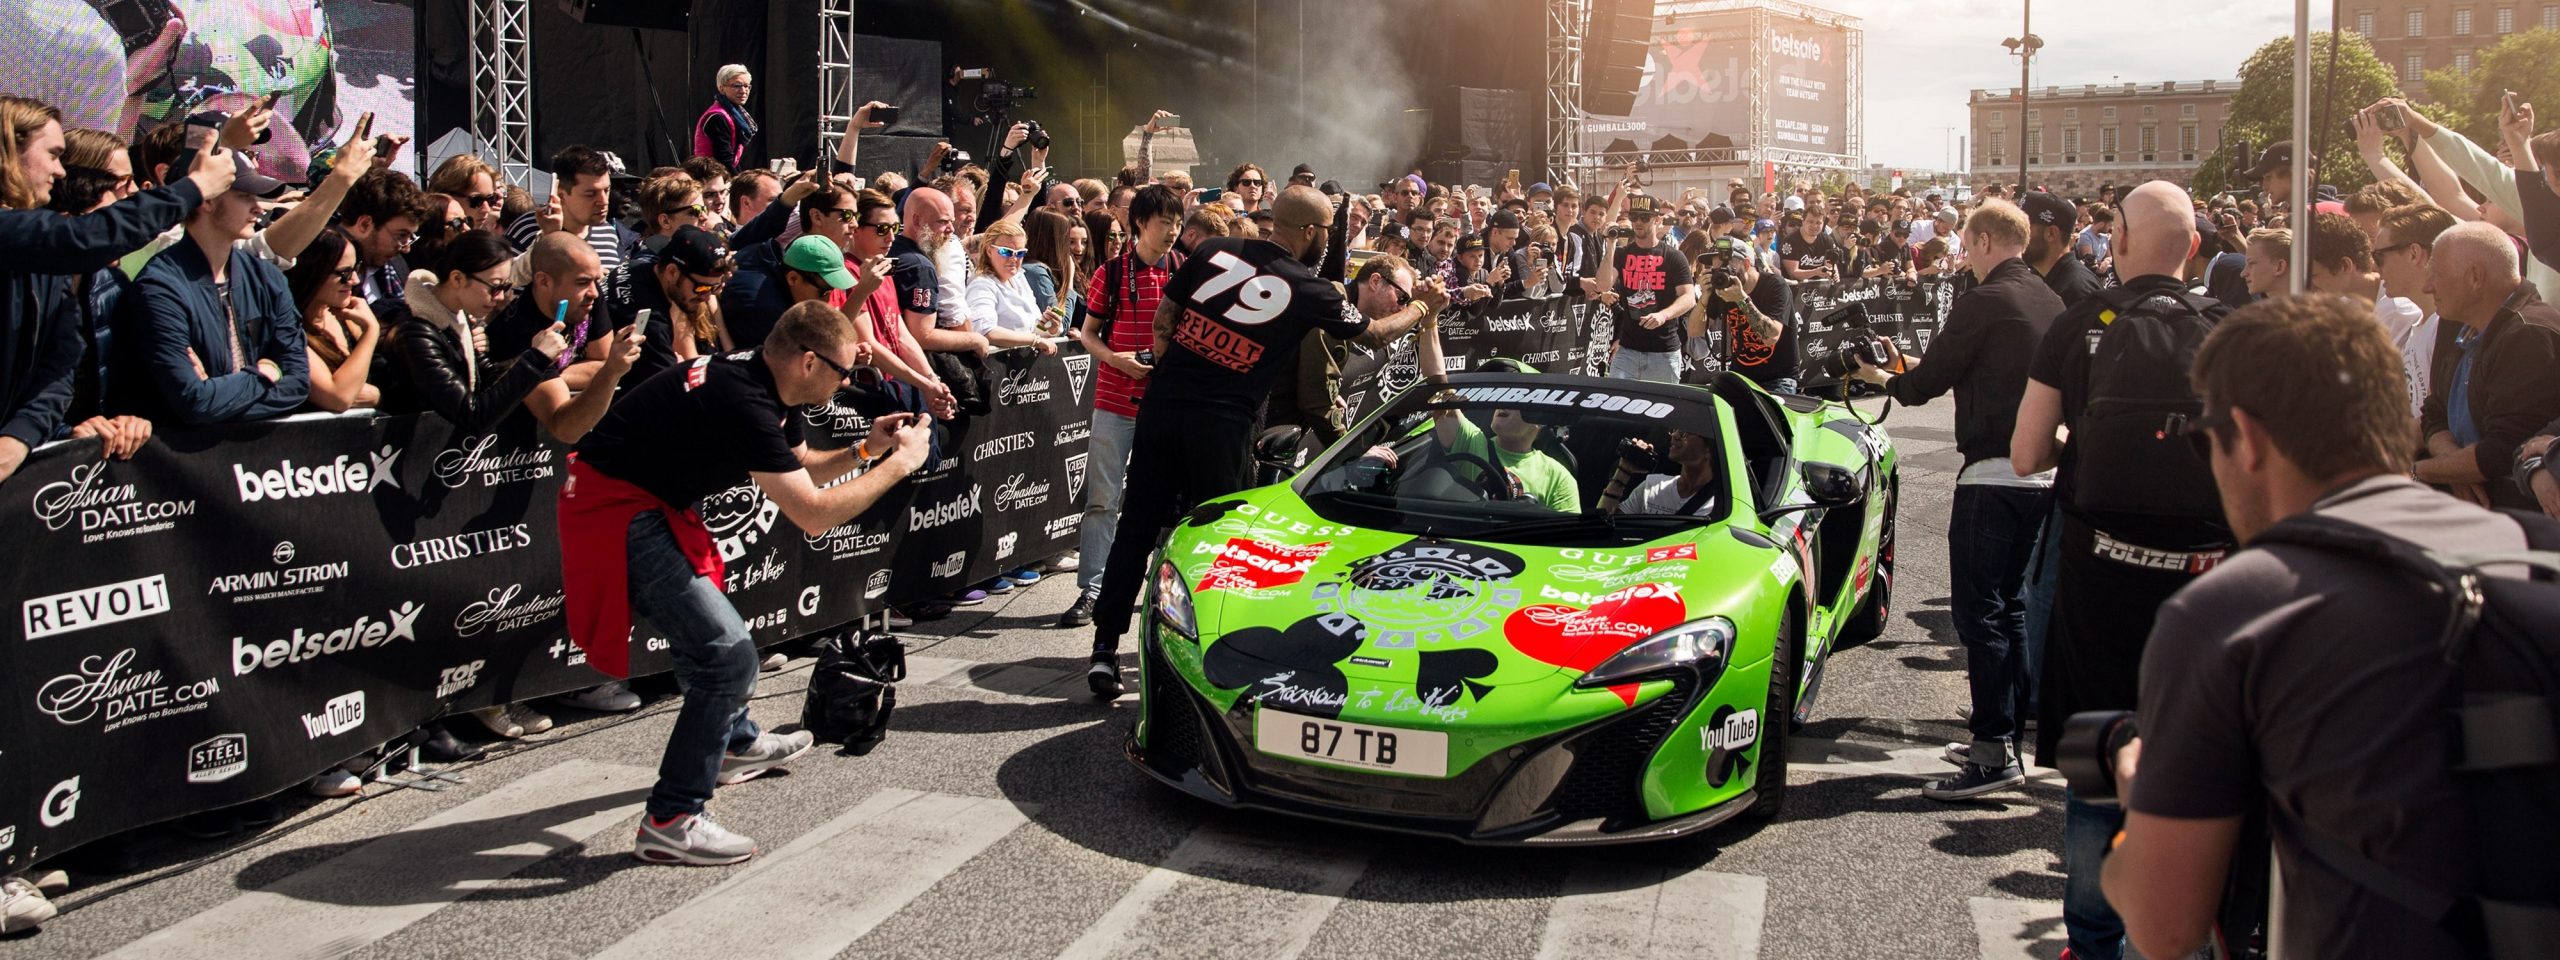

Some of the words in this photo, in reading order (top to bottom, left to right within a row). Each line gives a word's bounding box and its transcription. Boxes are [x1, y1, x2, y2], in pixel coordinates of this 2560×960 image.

[1771, 29, 1821, 62] betsafe
[1786, 87, 1799, 97] TEAM
[1823, 125, 1830, 134] UP
[1625, 254, 1664, 272] DEEP
[1191, 250, 1292, 325] 79
[1622, 268, 1666, 290] THREE
[1486, 314, 1525, 332] betsafe
[1182, 311, 1263, 363] REVOLT
[1069, 359, 1088, 371] GUESS
[1172, 333, 1254, 373] RACING
[1444, 357, 1466, 369] VOLT
[998, 368, 1050, 405] Anastasia
[1017, 392, 1050, 404] DATE.COM
[1453, 387, 1581, 406] UMBALL
[1580, 393, 1674, 418] 3000
[1061, 420, 1087, 431] CHAMPAGNE
[974, 431, 1035, 462] CHRISTIE'S
[433, 433, 552, 488] Anastasia
[1068, 459, 1086, 472] GUESS
[233, 454, 368, 503] betsafe
[483, 465, 554, 487] DATE.COM
[33, 460, 137, 530] Asian
[994, 473, 1050, 512] Anastasia
[1015, 494, 1048, 510] DATE.COM
[82, 500, 196, 531] DATE.COM
[909, 494, 969, 532] betsafe
[1052, 512, 1085, 531] BATTERY
[1236, 504, 1356, 536] GUESS
[83, 532, 104, 544] Love
[106, 528, 135, 539] Knows
[391, 523, 531, 569] CHRISTIE'S
[833, 533, 890, 553] DATE.COM
[998, 531, 1018, 550] TOP
[931, 553, 964, 578] YouTube
[1560, 546, 1694, 566] GUESS
[2094, 537, 2187, 571] POLIZEI
[208, 570, 278, 595] ARMIN
[283, 561, 348, 586] STROM
[869, 575, 888, 588] STEEL
[278, 586, 324, 598] MANUFACTURE
[1540, 584, 1653, 605] betsafe
[29, 580, 162, 633] REVOLT
[454, 584, 566, 637] Anastasia
[1524, 607, 1608, 626] Asian
[496, 609, 561, 632] DATE.COM
[1563, 621, 1652, 636] DATE.COM
[232, 616, 387, 677] betsafe
[440, 659, 486, 682] TOP
[37, 648, 163, 725] Asian
[106, 677, 220, 721] DATE.COM
[104, 720, 121, 733] Love
[122, 713, 147, 727] Knows
[149, 711, 160, 720] no
[162, 701, 208, 717] Boundaries
[301, 697, 363, 740] YouTube
[1301, 721, 1343, 757] 87
[1354, 728, 1397, 765] TB
[1700, 712, 1755, 750] YouTube
[195, 742, 242, 765] STEEL
[195, 769, 217, 780] ALLOY
